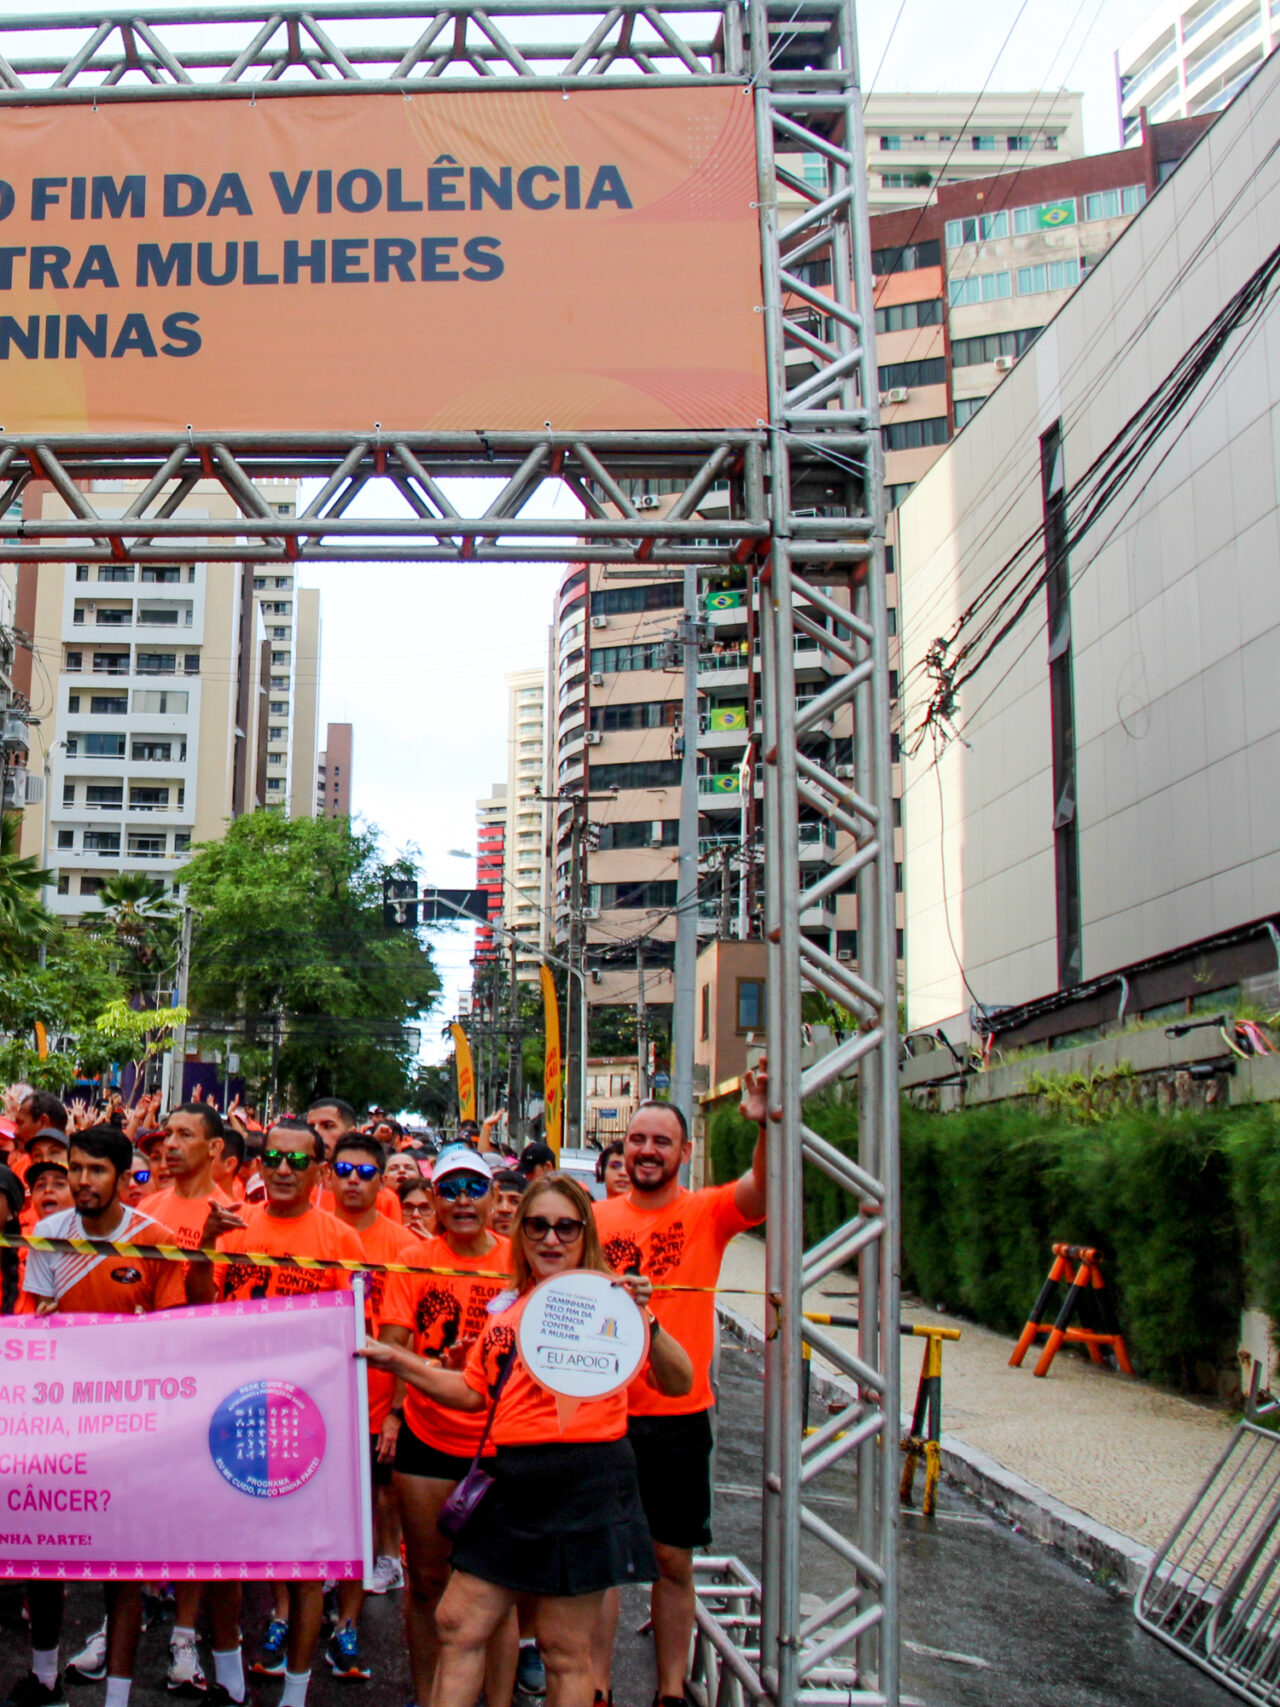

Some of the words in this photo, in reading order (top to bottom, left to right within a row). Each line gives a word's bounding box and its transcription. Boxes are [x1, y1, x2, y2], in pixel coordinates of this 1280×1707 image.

[30, 174, 147, 221] FIM
[163, 172, 253, 218] DA
[268, 154, 633, 215] VIOLÊNCIA
[136, 236, 505, 289] MULHERES
[278, 1273, 320, 1293] CONTRA
[545, 1303, 565, 1313] PELO
[566, 1307, 580, 1316] FIM
[581, 1311, 592, 1319] DA
[546, 1295, 596, 1312] CAMINHADA
[542, 1320, 575, 1332] CONTRA
[544, 1311, 585, 1326] VIOLÊNCIA
[547, 1330, 581, 1341] MULHER
[547, 1351, 564, 1364] EU
[566, 1354, 610, 1369] APOIO
[32, 1382, 64, 1405] 30
[72, 1377, 197, 1404] MINUTOS
[78, 1412, 157, 1435] IMPEDE
[247, 1476, 291, 1488] PROGRAMA
[7, 1483, 112, 1512] CÂNCER?
[37, 1534, 92, 1546] PARTE!
